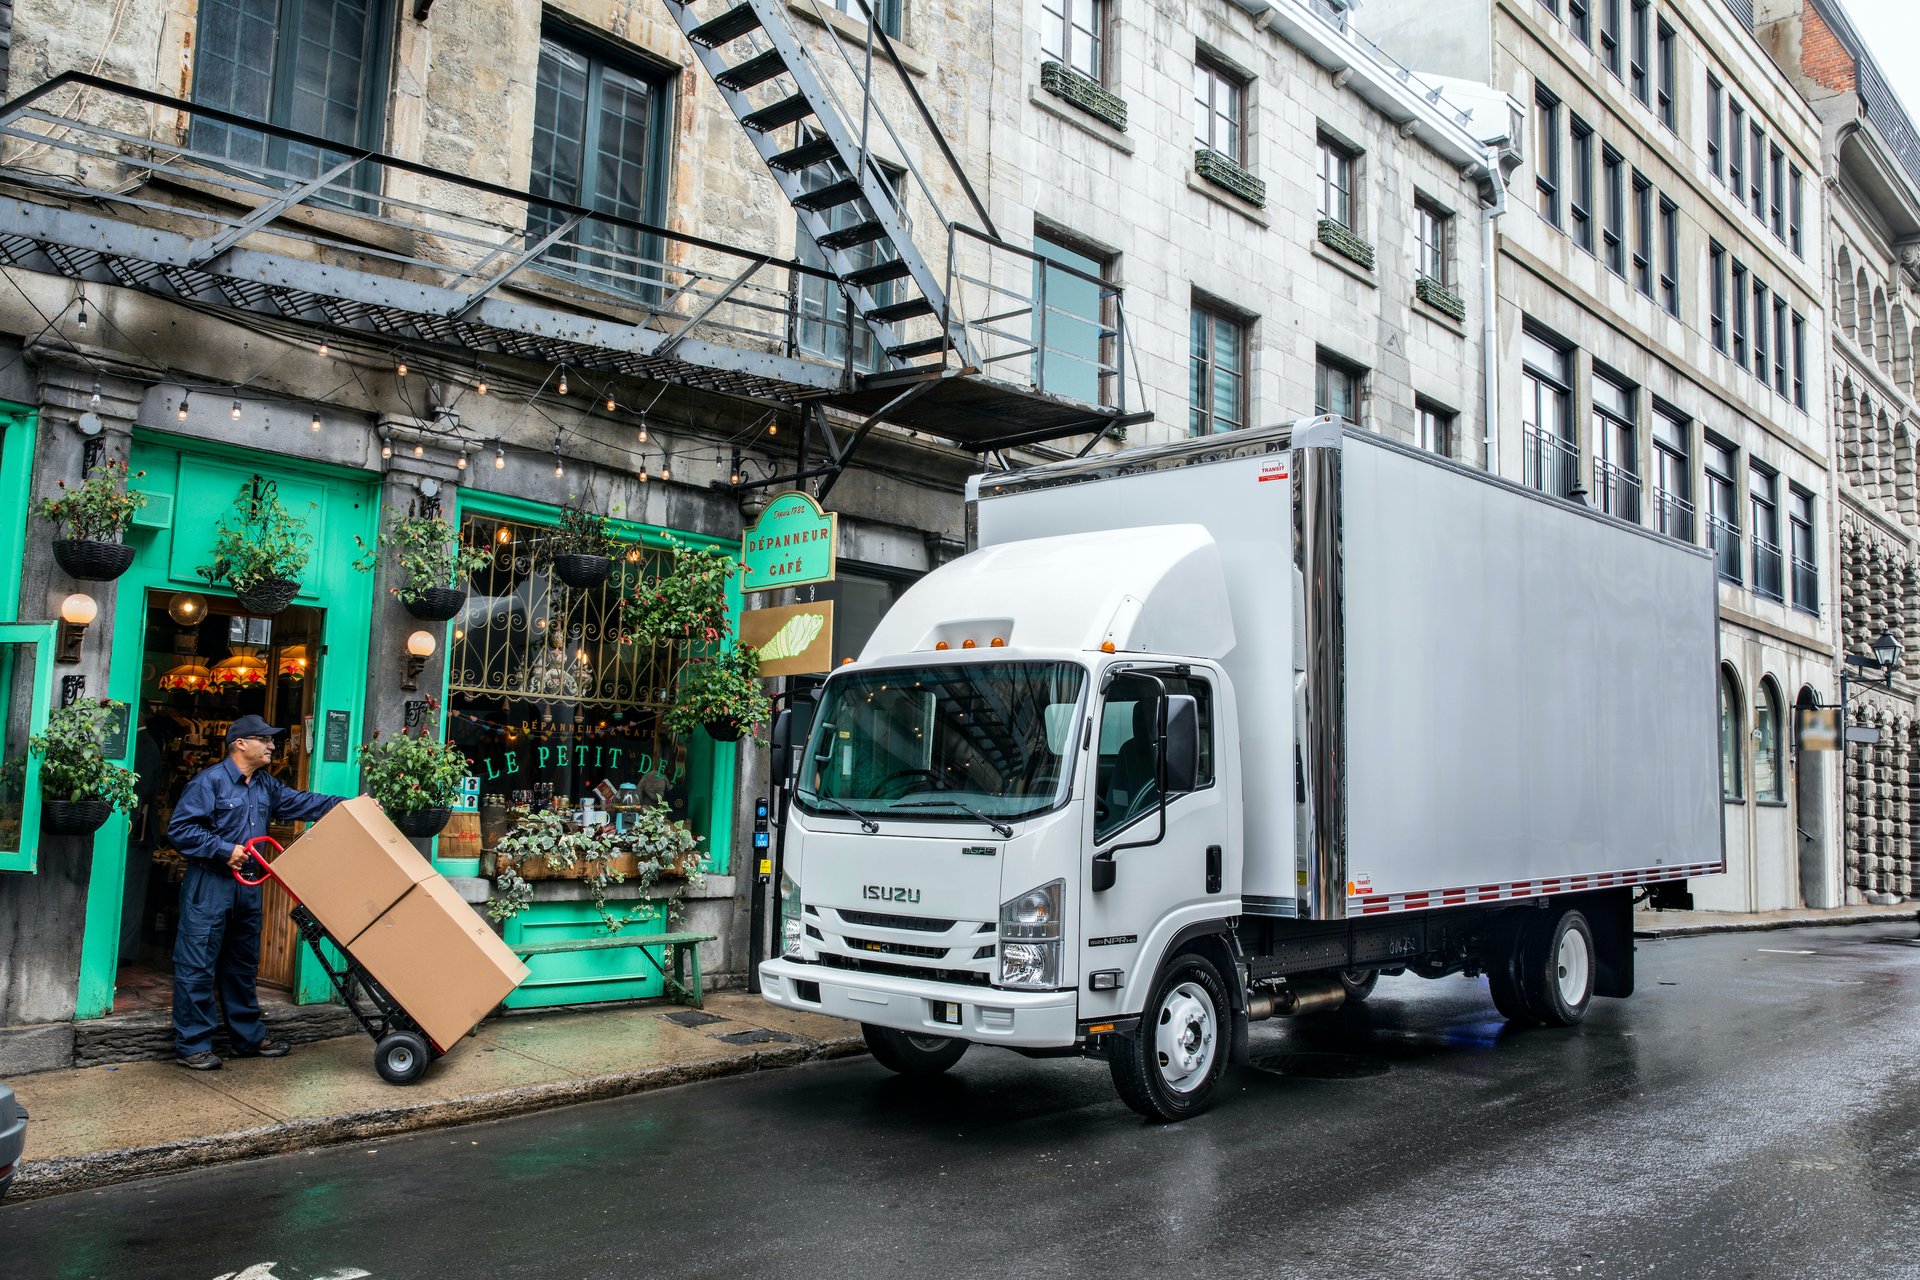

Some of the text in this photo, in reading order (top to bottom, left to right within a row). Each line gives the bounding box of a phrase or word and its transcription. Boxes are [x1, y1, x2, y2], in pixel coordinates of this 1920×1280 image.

[749, 528, 829, 552] DÉPANNEUR
[769, 556, 803, 576] CAFÉ
[521, 718, 602, 735] DÉPANNEUR
[483, 750, 520, 781] LE
[537, 745, 623, 769] PETIT
[457, 832, 477, 841] ATM
[863, 884, 921, 903] ISUZU
[1103, 937, 1127, 945] NPR
